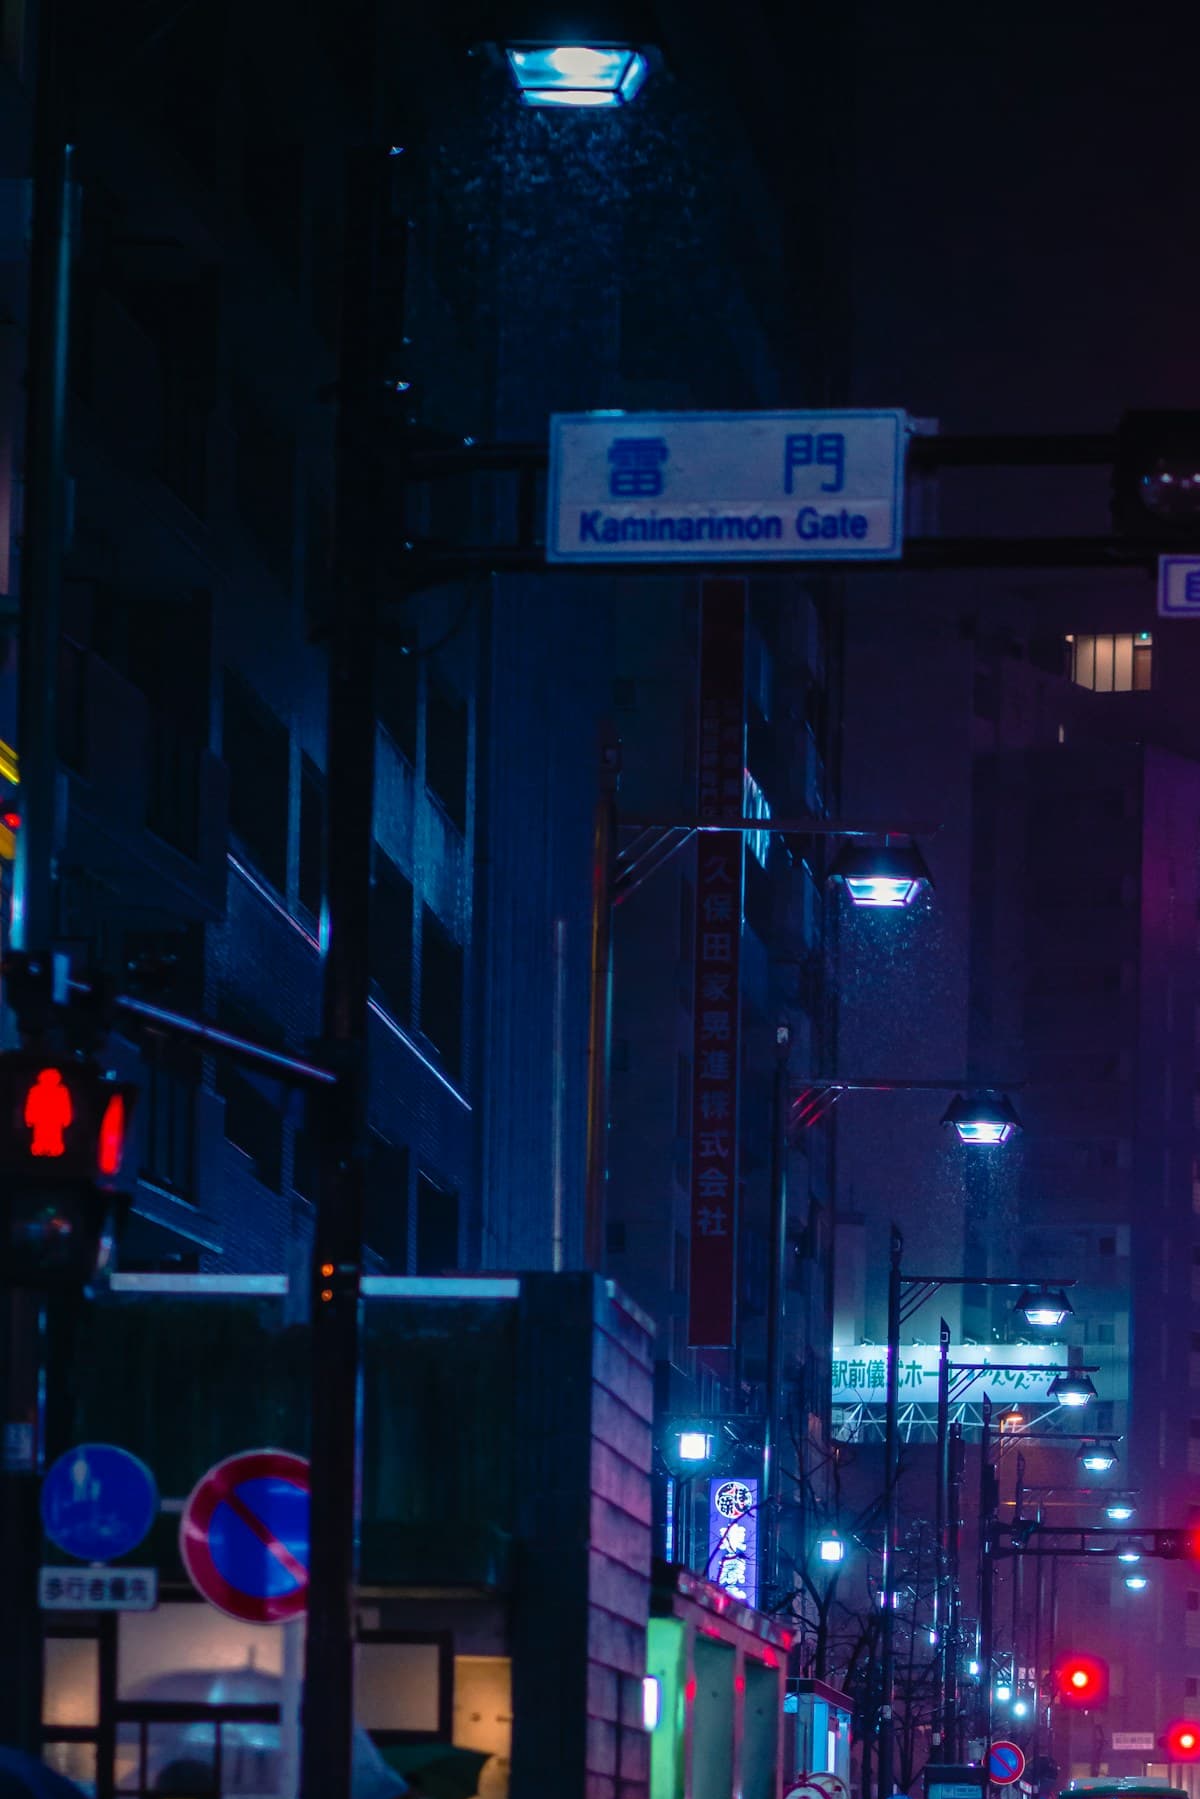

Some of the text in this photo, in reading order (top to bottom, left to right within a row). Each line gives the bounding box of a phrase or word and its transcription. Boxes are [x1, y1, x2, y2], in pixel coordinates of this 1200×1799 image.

[608, 433, 845, 496] 雷門
[579, 508, 868, 541] Kaminarimon Gate
